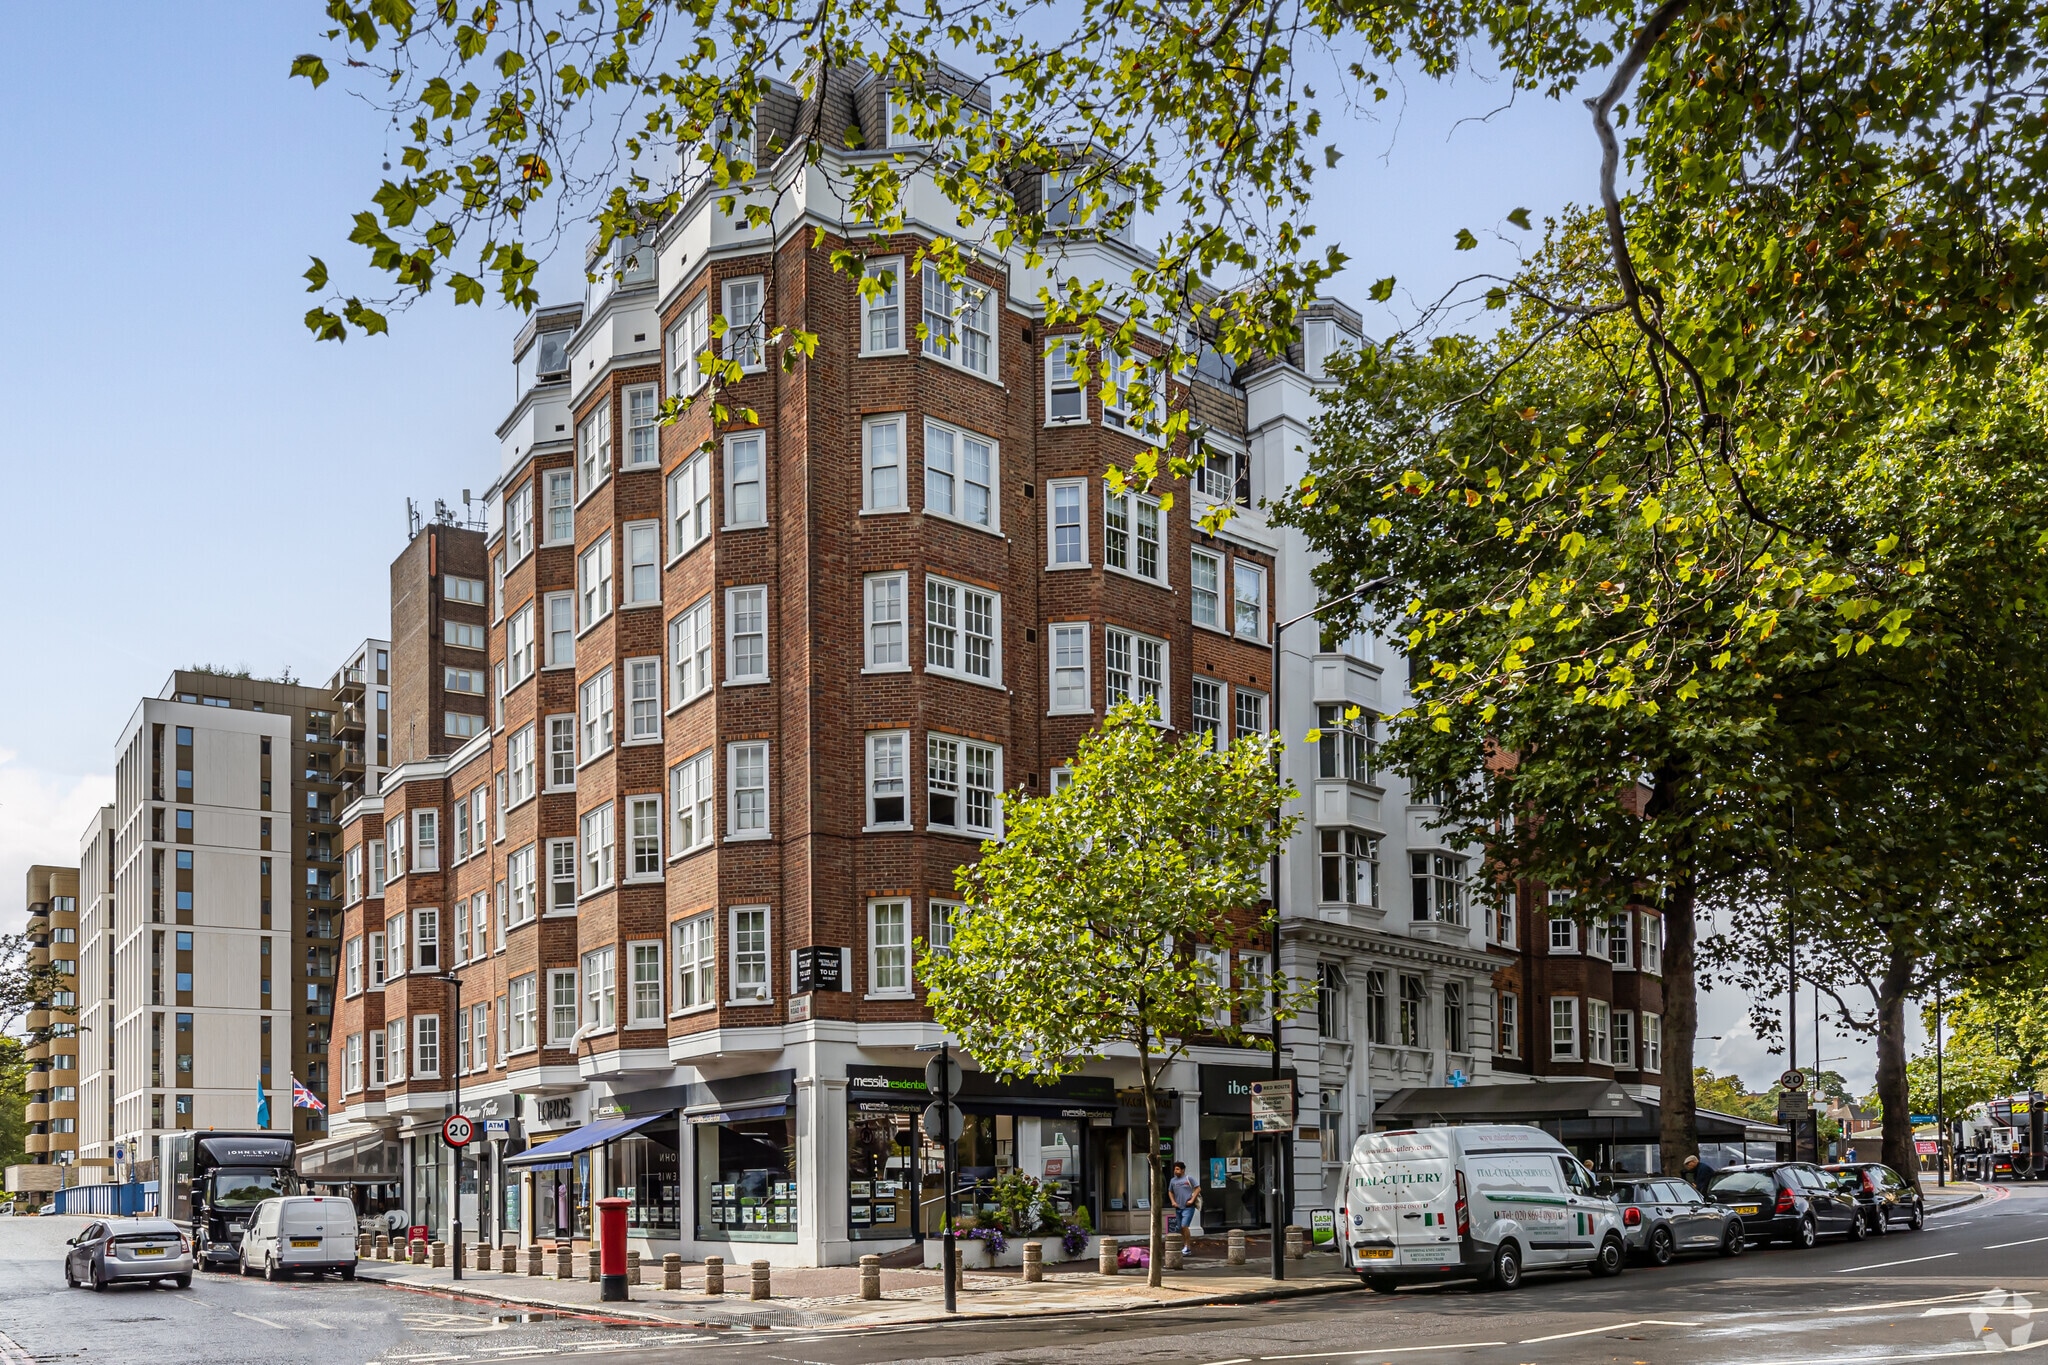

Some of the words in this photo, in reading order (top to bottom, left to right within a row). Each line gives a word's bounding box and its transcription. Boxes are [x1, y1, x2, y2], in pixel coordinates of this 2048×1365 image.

[1784, 1075, 1801, 1084] 20
[538, 1097, 572, 1121] LORDS
[449, 1124, 470, 1137] 20
[488, 1121, 504, 1129] ATM
[1160, 1142, 1171, 1151] ash
[1355, 1173, 1442, 1187] ITAL-CUTLERY
